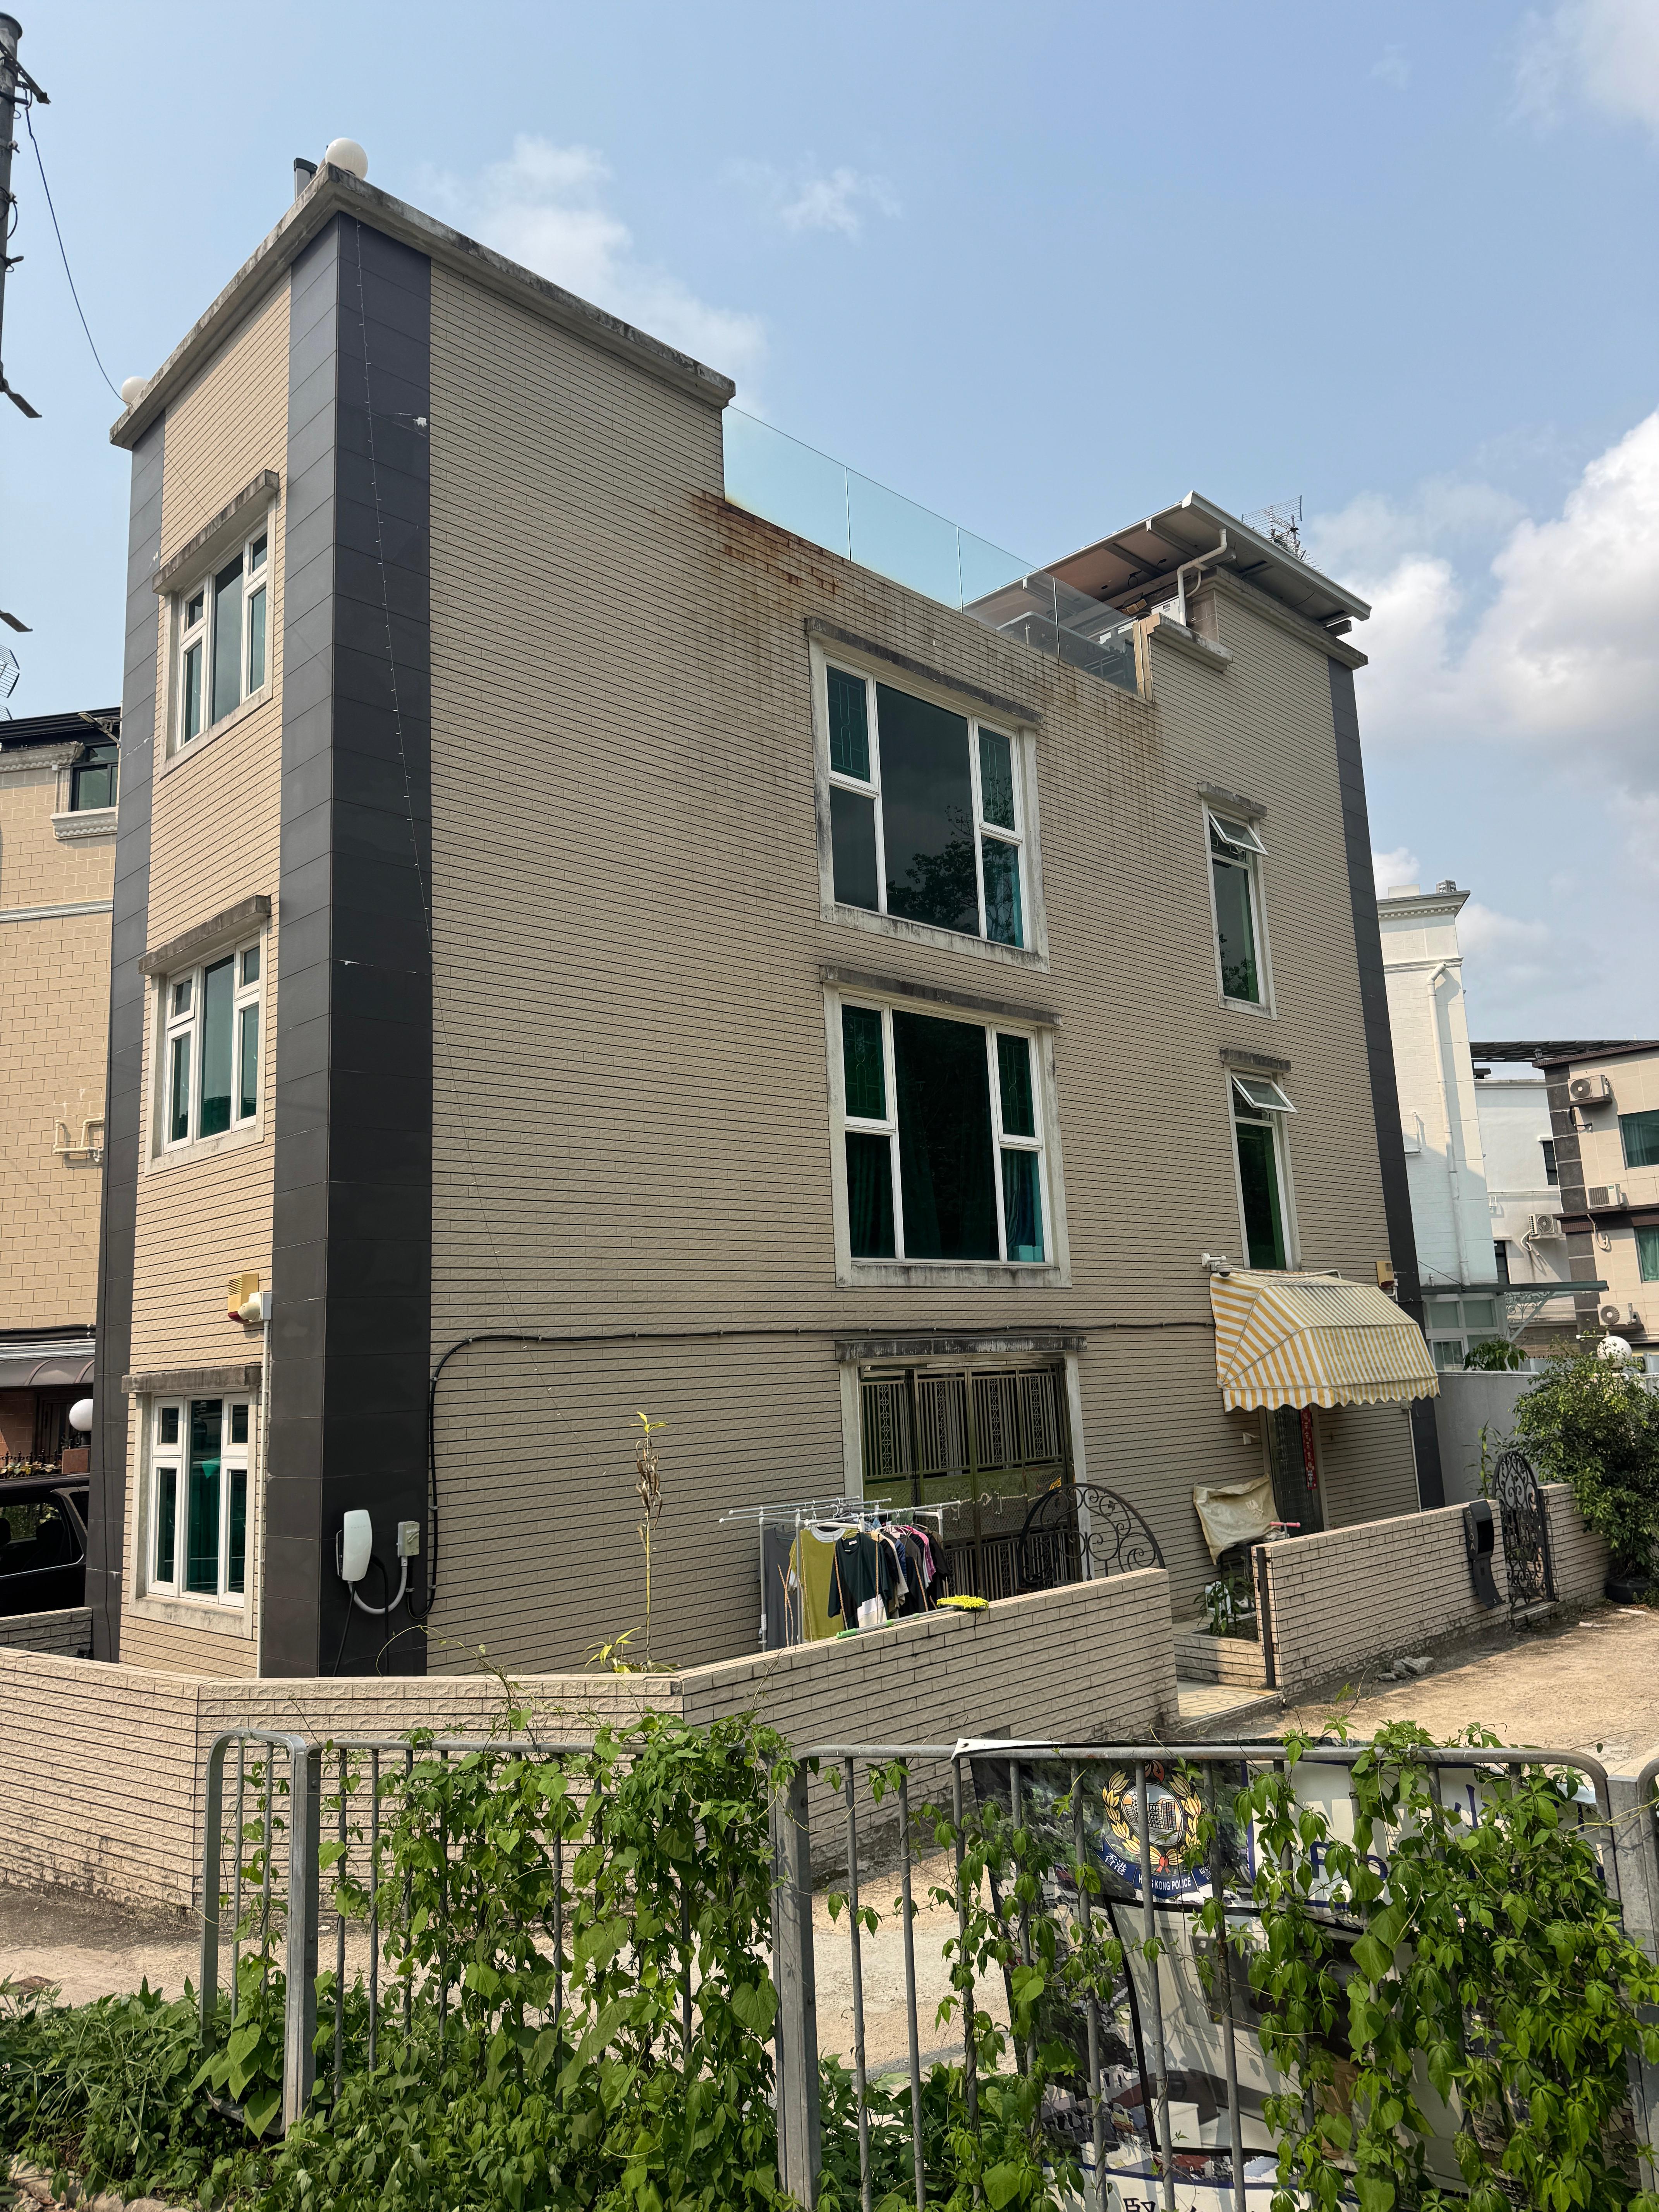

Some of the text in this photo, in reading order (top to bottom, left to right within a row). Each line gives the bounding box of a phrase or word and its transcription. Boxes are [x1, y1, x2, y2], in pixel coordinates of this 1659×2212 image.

[1105, 1852, 1127, 1875] 香港
[1155, 1880, 1170, 1891] KONG
[1171, 1877, 1191, 1890] POLICE
